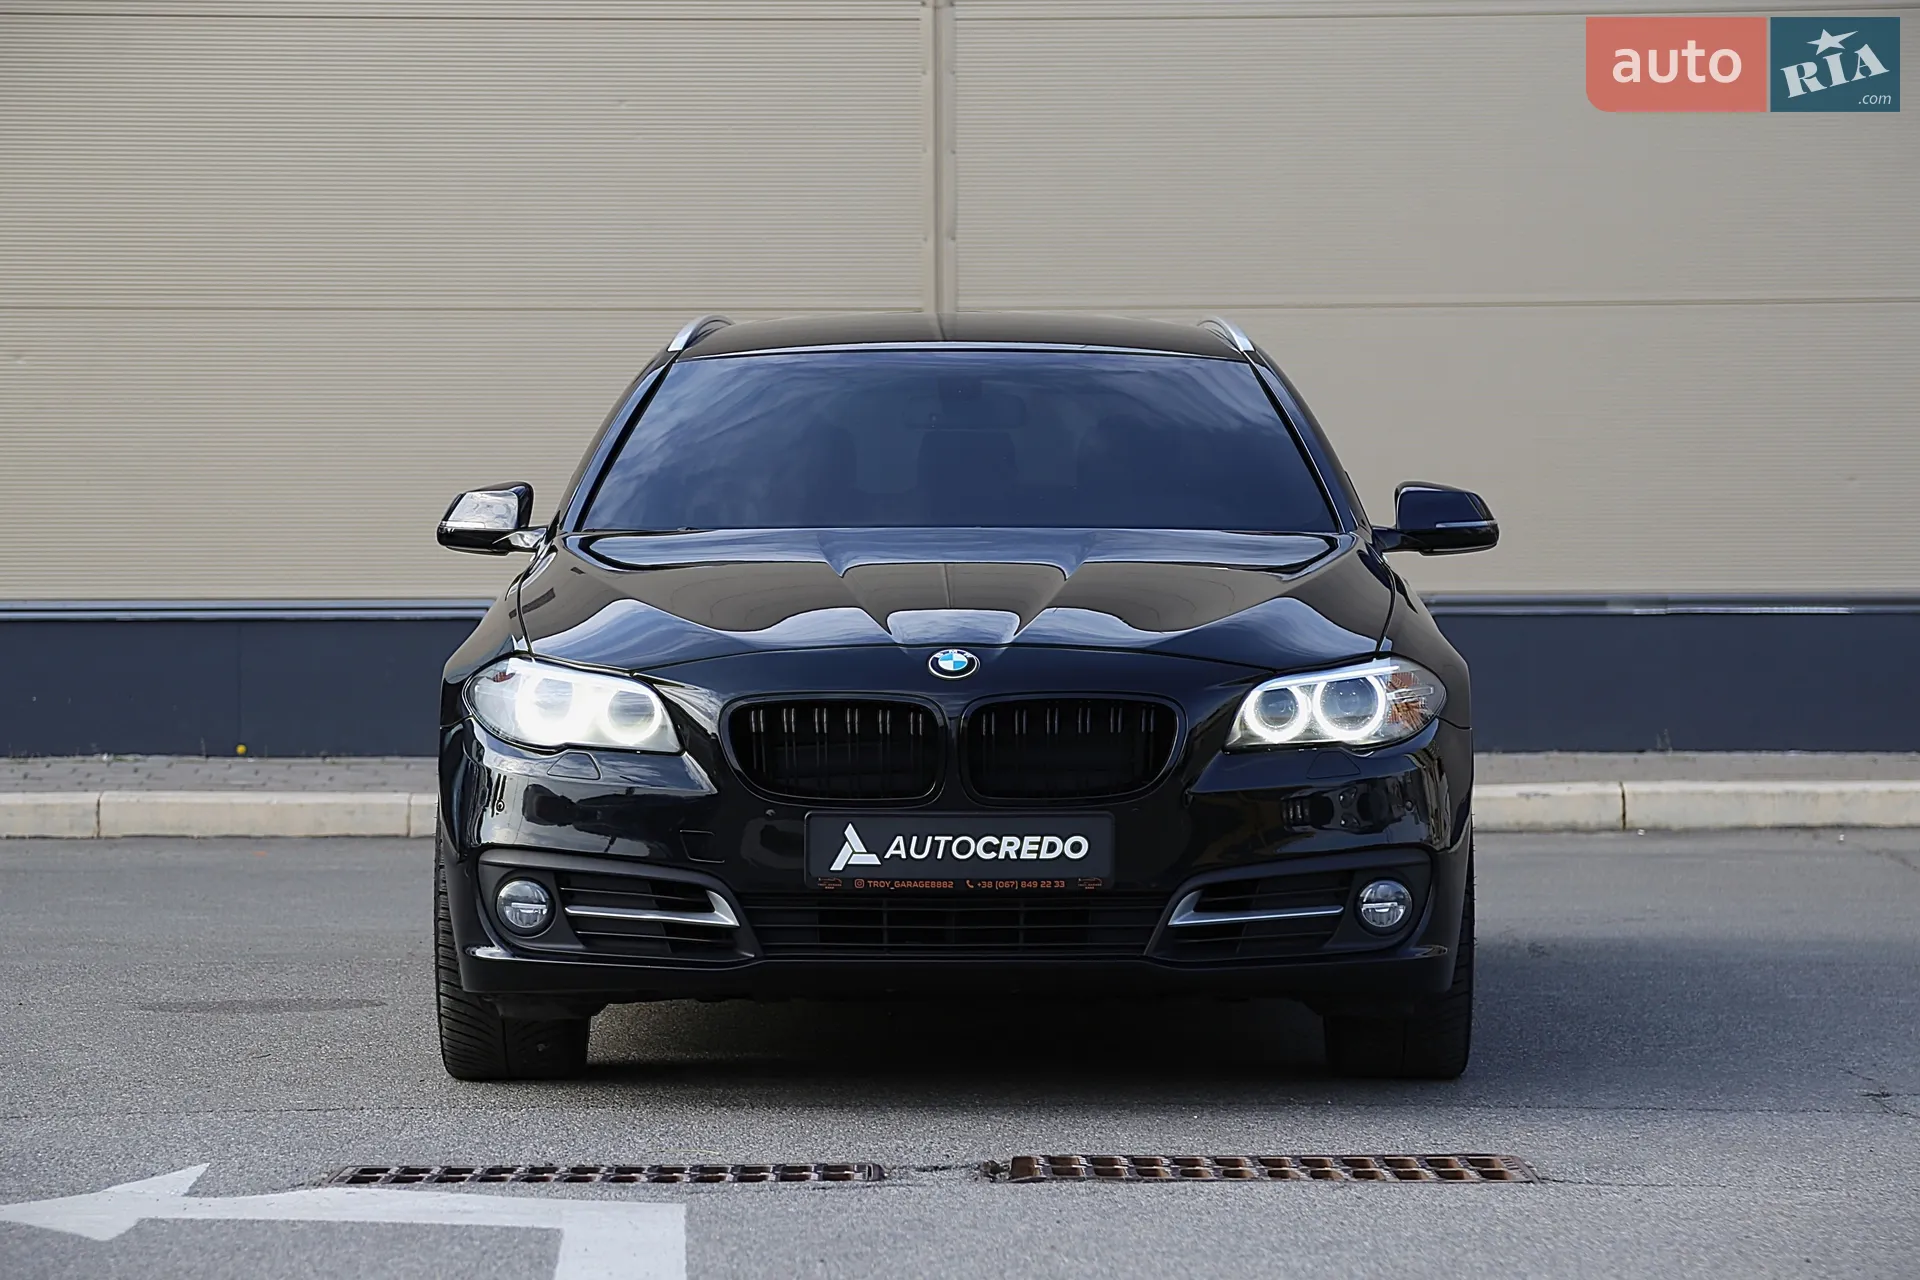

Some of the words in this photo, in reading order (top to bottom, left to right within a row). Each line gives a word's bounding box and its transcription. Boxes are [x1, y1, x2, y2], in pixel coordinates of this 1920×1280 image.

[884, 835, 1089, 859] AUTOCREDO
[995, 880, 1018, 889] (067)
[1020, 880, 1037, 888] 849
[1040, 880, 1052, 888] 22
[1053, 880, 1065, 888] 33
